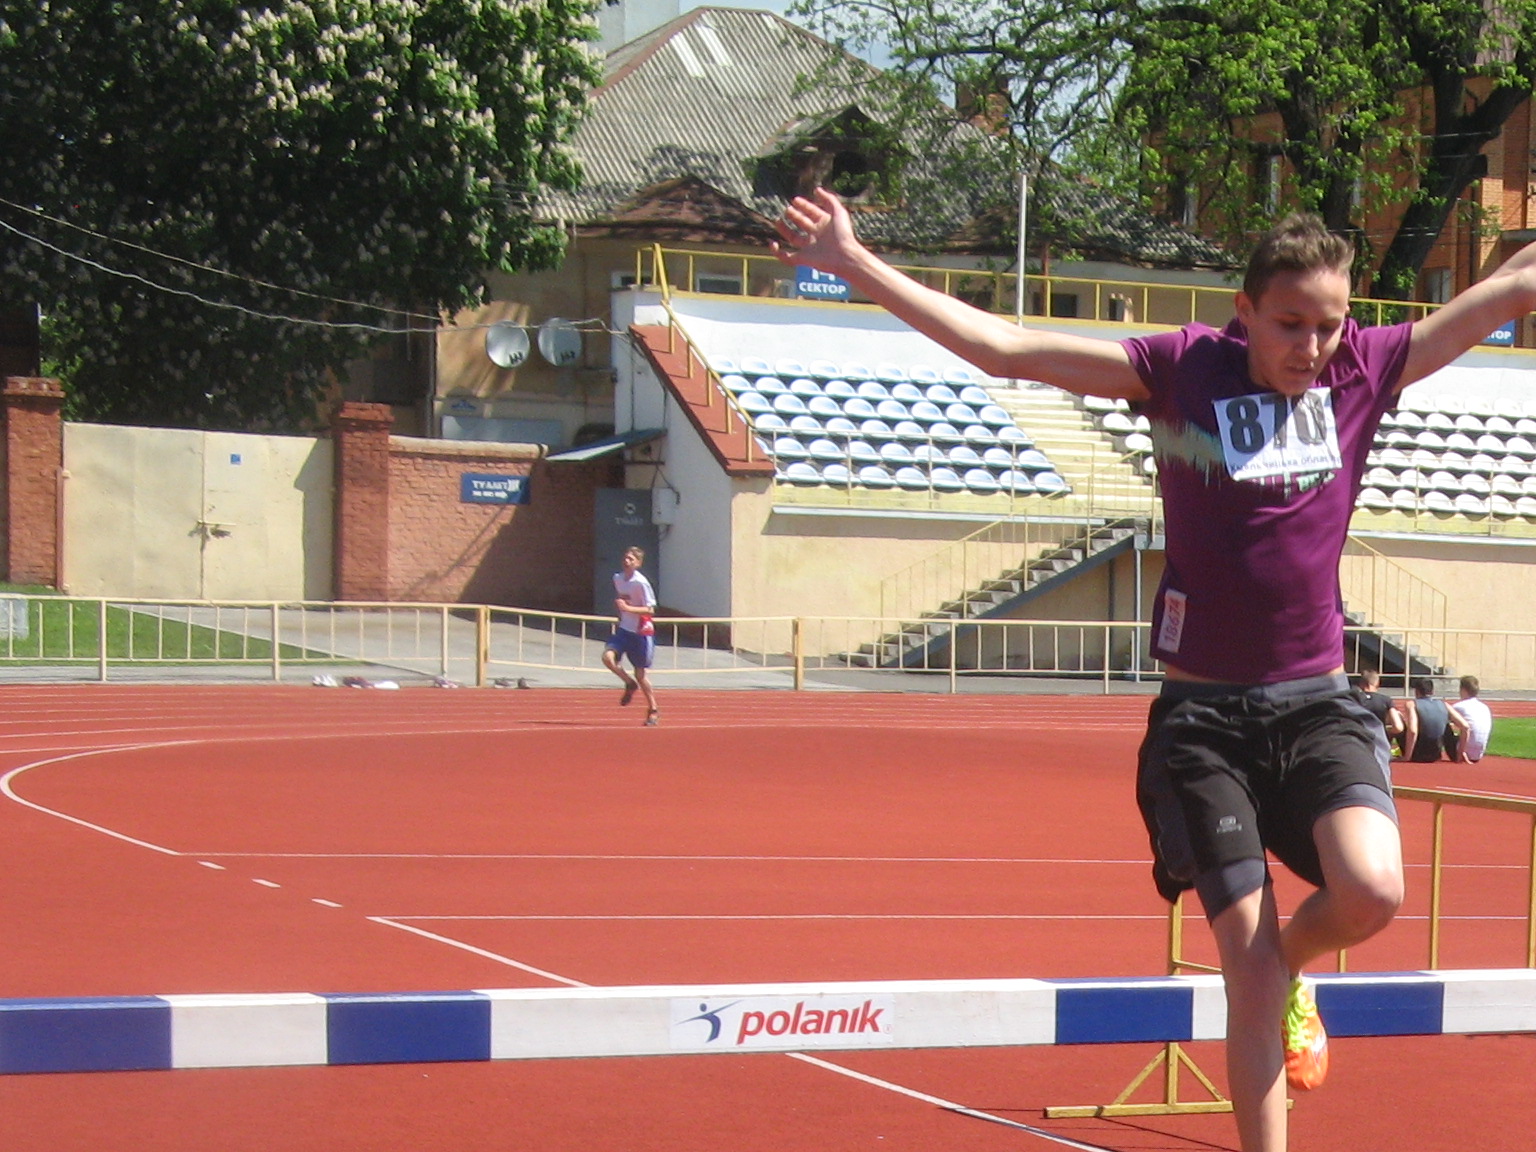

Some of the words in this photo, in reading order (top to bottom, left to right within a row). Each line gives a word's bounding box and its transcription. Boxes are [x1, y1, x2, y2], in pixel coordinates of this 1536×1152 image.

[799, 281, 846, 295] СЕКТОР
[1226, 391, 1328, 454] 870
[735, 999, 885, 1046] polanik
